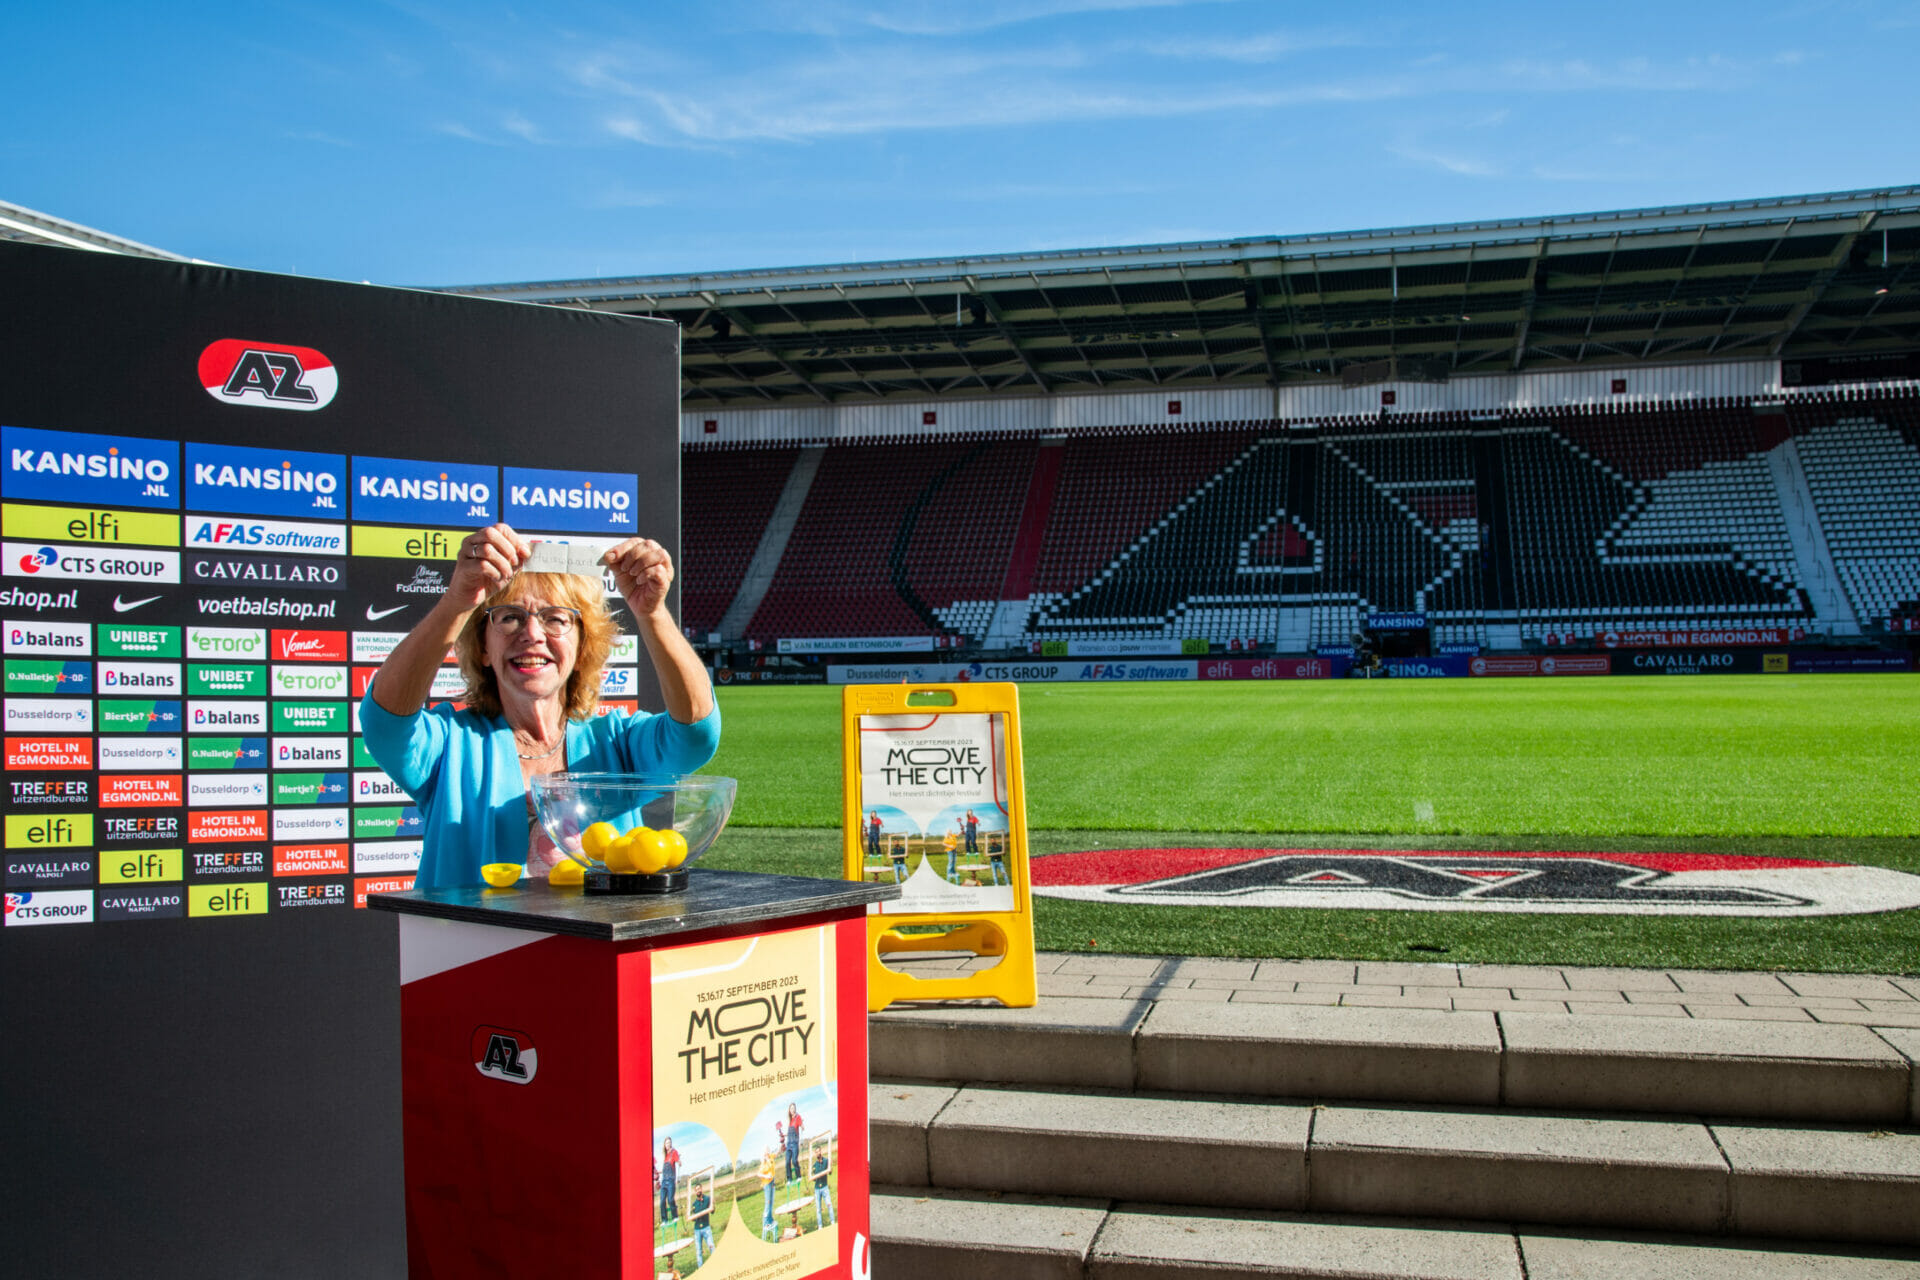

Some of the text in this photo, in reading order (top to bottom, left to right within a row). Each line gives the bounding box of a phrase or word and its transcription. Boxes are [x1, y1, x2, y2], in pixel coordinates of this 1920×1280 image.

[222, 348, 318, 403] AZ
[12, 447, 169, 482] KANSINO
[194, 461, 337, 494] KANSINO
[142, 485, 169, 497] .NL
[361, 473, 489, 503] KANSINO
[312, 496, 337, 508] .NL
[511, 482, 630, 510] KANSINO
[467, 505, 489, 517] .NL
[609, 513, 630, 523] .NL
[68, 512, 119, 540] elfi
[193, 523, 340, 549] AFAS software
[405, 532, 448, 558] elfi
[60, 557, 164, 576] CTS GROUP
[194, 561, 338, 583] CAVALLARO
[198, 596, 336, 620] voetbalshop.nl
[1369, 615, 1424, 628] KANSINO
[27, 631, 83, 647] balans
[110, 630, 168, 643] UNIBET
[1672, 632, 1688, 645] IN
[1690, 630, 1781, 644] EGMOND.NL
[282, 632, 324, 657] Vomar
[1045, 641, 1064, 654] elfi
[1185, 640, 1206, 653] elfi
[1634, 654, 1734, 667] CAVALLARO
[985, 666, 1058, 679] CTS GROUP
[1080, 664, 1188, 679] AFAS software
[1208, 661, 1321, 677] elfi elfi elfi
[1386, 660, 1445, 677] SINO.NL
[120, 672, 174, 687] balans
[199, 670, 254, 682] UNIBET
[8, 709, 73, 721] Dusseldorp
[208, 710, 260, 724] balans
[284, 708, 336, 719] UNIBET
[20, 743, 79, 753] HOTEL IN
[102, 748, 163, 759] Dusseldorp
[292, 747, 341, 760] balans
[9, 755, 89, 765] EGMOND.NL
[887, 747, 980, 766] MOVE
[880, 767, 987, 785] THE CITY
[11, 782, 88, 795] TREFFER
[113, 780, 169, 790] HOTEL IN
[191, 785, 249, 795] Dusseldorp
[372, 781, 406, 794] bala
[13, 795, 88, 804] uitzendbureau
[103, 792, 179, 802] EGMOND.NL
[104, 818, 177, 831] TREFFER
[201, 815, 255, 826] HOTEL IN
[276, 819, 331, 829] Dusseldorp
[27, 819, 72, 843] elfi
[106, 831, 177, 840] uitzendbureau
[191, 828, 264, 838] EGMOND.NL
[193, 852, 263, 866] TREFFER
[286, 849, 337, 860] HOTEL IN
[357, 851, 410, 862] Dusseldorp
[8, 861, 90, 873] CAVALLARO
[120, 855, 162, 878] elfi
[195, 864, 263, 874] uitzendbureau
[276, 861, 345, 871] EGMOND.NL
[366, 881, 414, 892] HOTEL IN
[1107, 854, 1821, 907] AZ
[278, 884, 344, 898] TREFFER
[102, 896, 180, 908] CAVALLARO
[208, 888, 249, 911] elfi
[280, 897, 344, 907] uitzendbureau
[16, 905, 87, 918] CTS GROUP
[726, 980, 778, 998] SEPTEMBER
[779, 976, 799, 988] 2023
[687, 989, 807, 1045] MOVE
[482, 1033, 528, 1079] AZ
[678, 1022, 815, 1083] THE CITY
[689, 1066, 807, 1105] Het meest dichtbije festival
